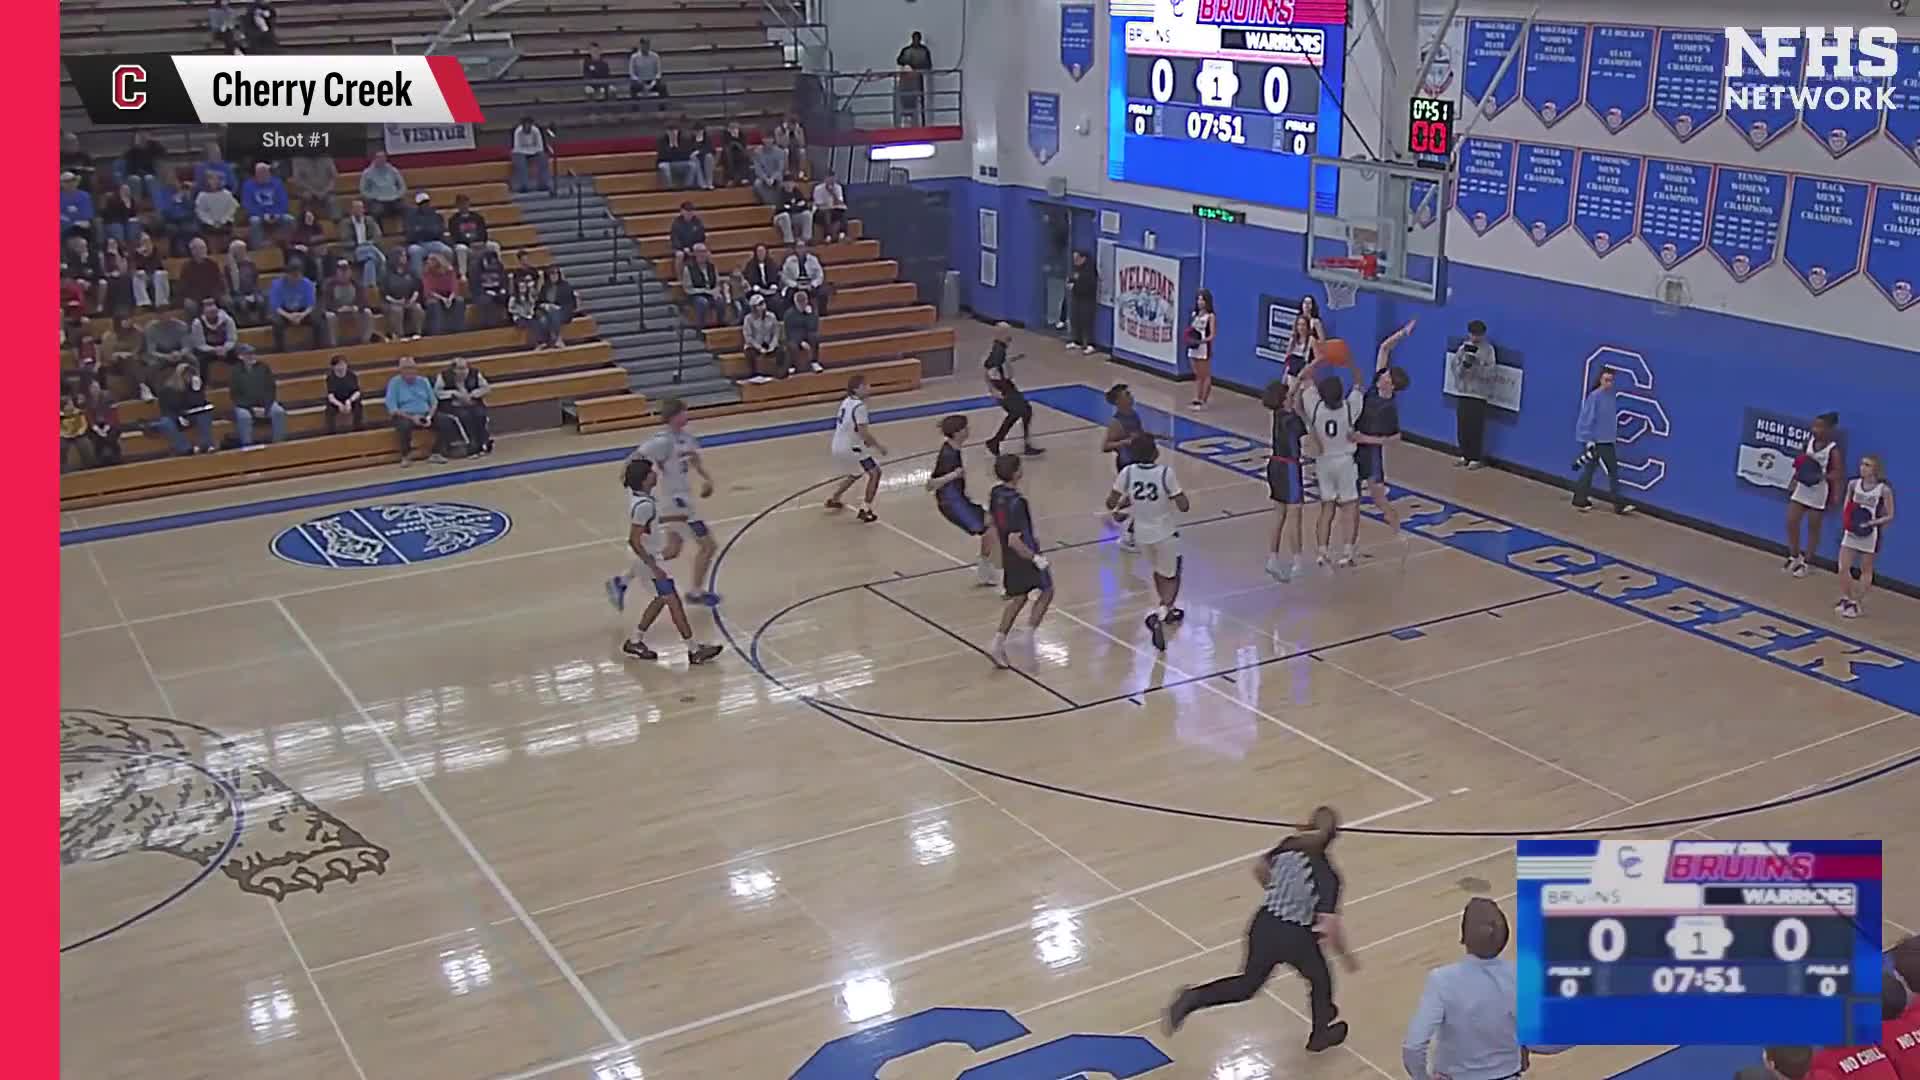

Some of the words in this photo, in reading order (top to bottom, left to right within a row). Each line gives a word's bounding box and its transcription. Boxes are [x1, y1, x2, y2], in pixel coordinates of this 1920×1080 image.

[1199, 0, 1295, 25] BRUINS
[1245, 31, 1322, 54] WARRIORS
[1151, 58, 1174, 103] 0
[1211, 76, 1223, 101] 1
[1263, 66, 1290, 114] 0
[1134, 116, 1146, 135] 0
[1187, 111, 1246, 144] 07:51
[1411, 120, 1447, 154] 00
[1293, 134, 1307, 155] 0
[1119, 265, 1176, 304] WELCOME
[1326, 419, 1338, 437] 0
[1756, 418, 1786, 436] HIGH
[1788, 426, 1811, 441] SCH
[1133, 480, 1159, 502] 23
[1506, 545, 1904, 684] CREEK
[1839, 1057, 1861, 1074] NO
